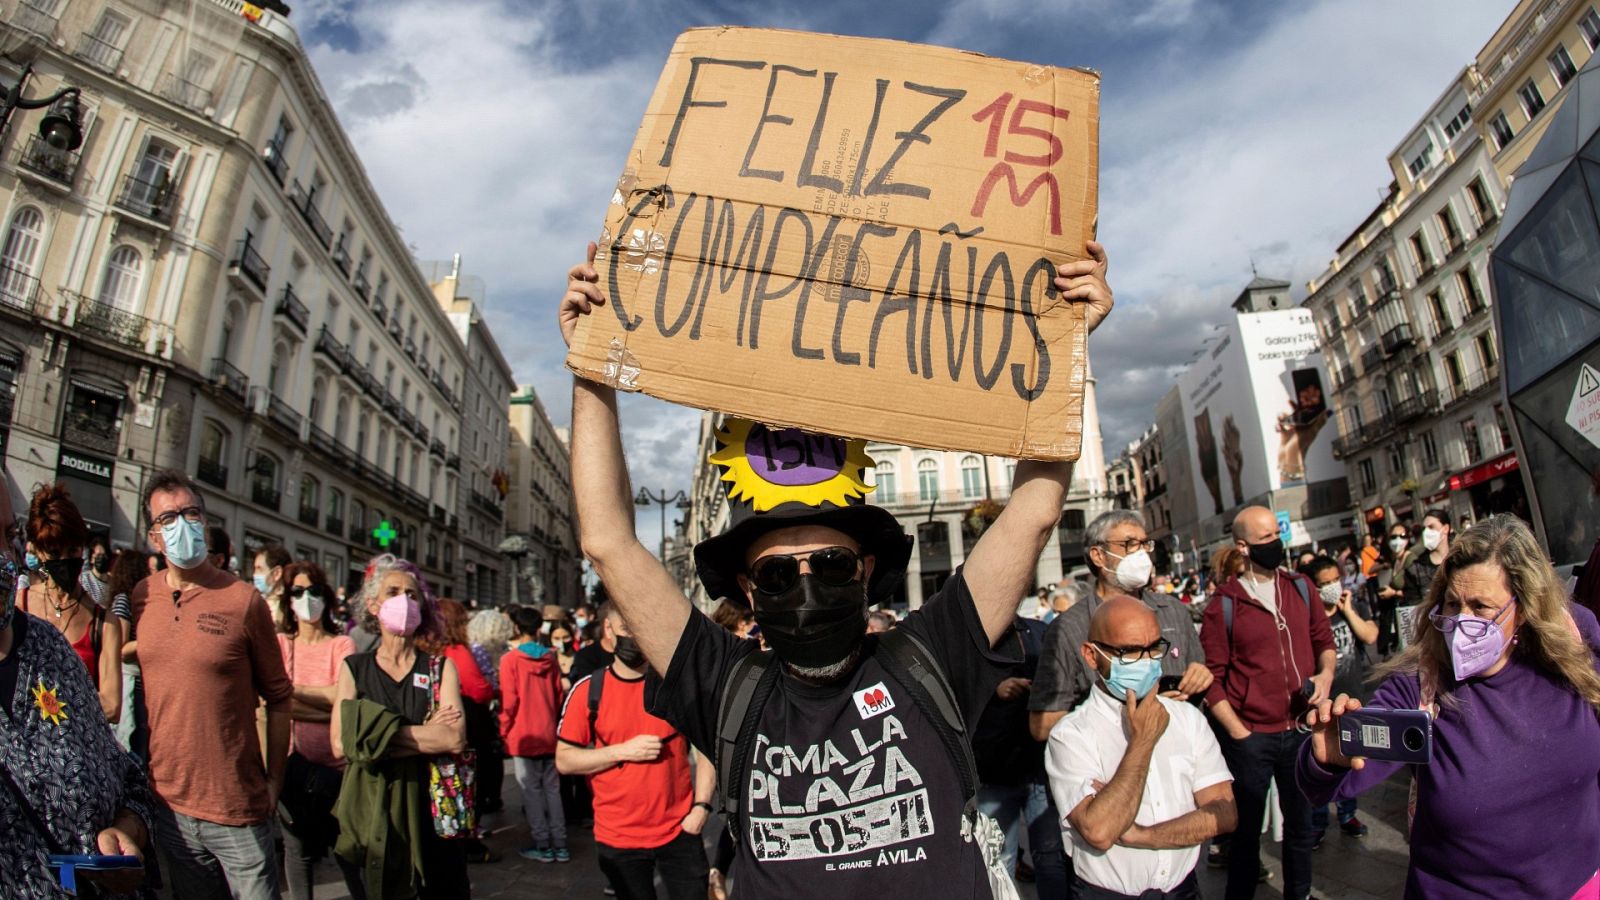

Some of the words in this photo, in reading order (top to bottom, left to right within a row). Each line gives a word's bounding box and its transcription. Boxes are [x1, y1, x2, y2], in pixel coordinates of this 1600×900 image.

[660, 57, 967, 200] FELIZ
[972, 92, 1070, 167] 15
[970, 162, 1062, 235] M
[608, 184, 1059, 401] COMPLEAÑOS
[61, 455, 110, 478] RODILLA
[750, 422, 843, 471] 15M
[862, 696, 891, 715] 15M
[753, 734, 849, 777] TOMA
[851, 715, 908, 756] LA
[749, 746, 923, 815] PLAZA
[826, 863, 836, 871] EL
[839, 859, 872, 871] GRANDE
[877, 846, 927, 867] ÁVILA
